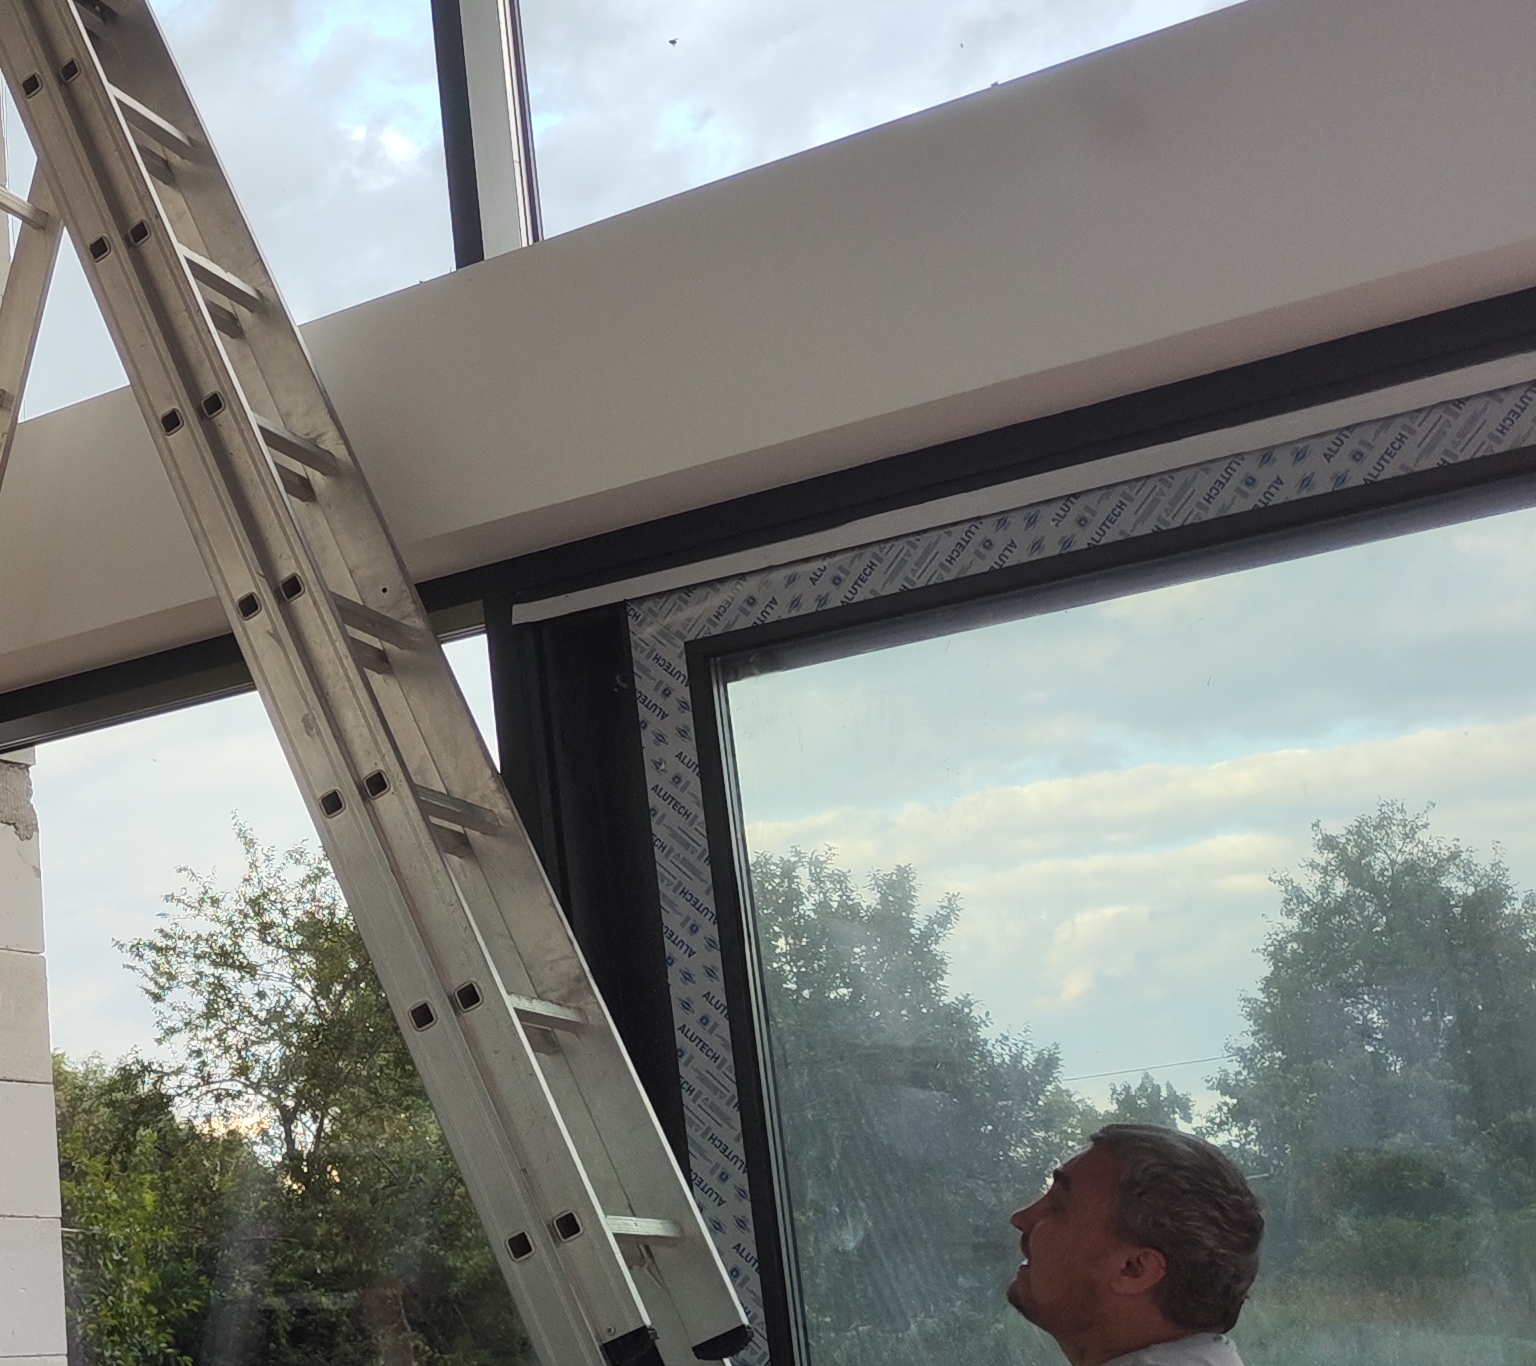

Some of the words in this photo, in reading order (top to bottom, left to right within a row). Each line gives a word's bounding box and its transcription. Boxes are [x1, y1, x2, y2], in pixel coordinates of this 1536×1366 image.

[945, 521, 984, 566] LUTECH
[651, 784, 692, 821] ALUTECH
[677, 1024, 720, 1063] ALUTECH
